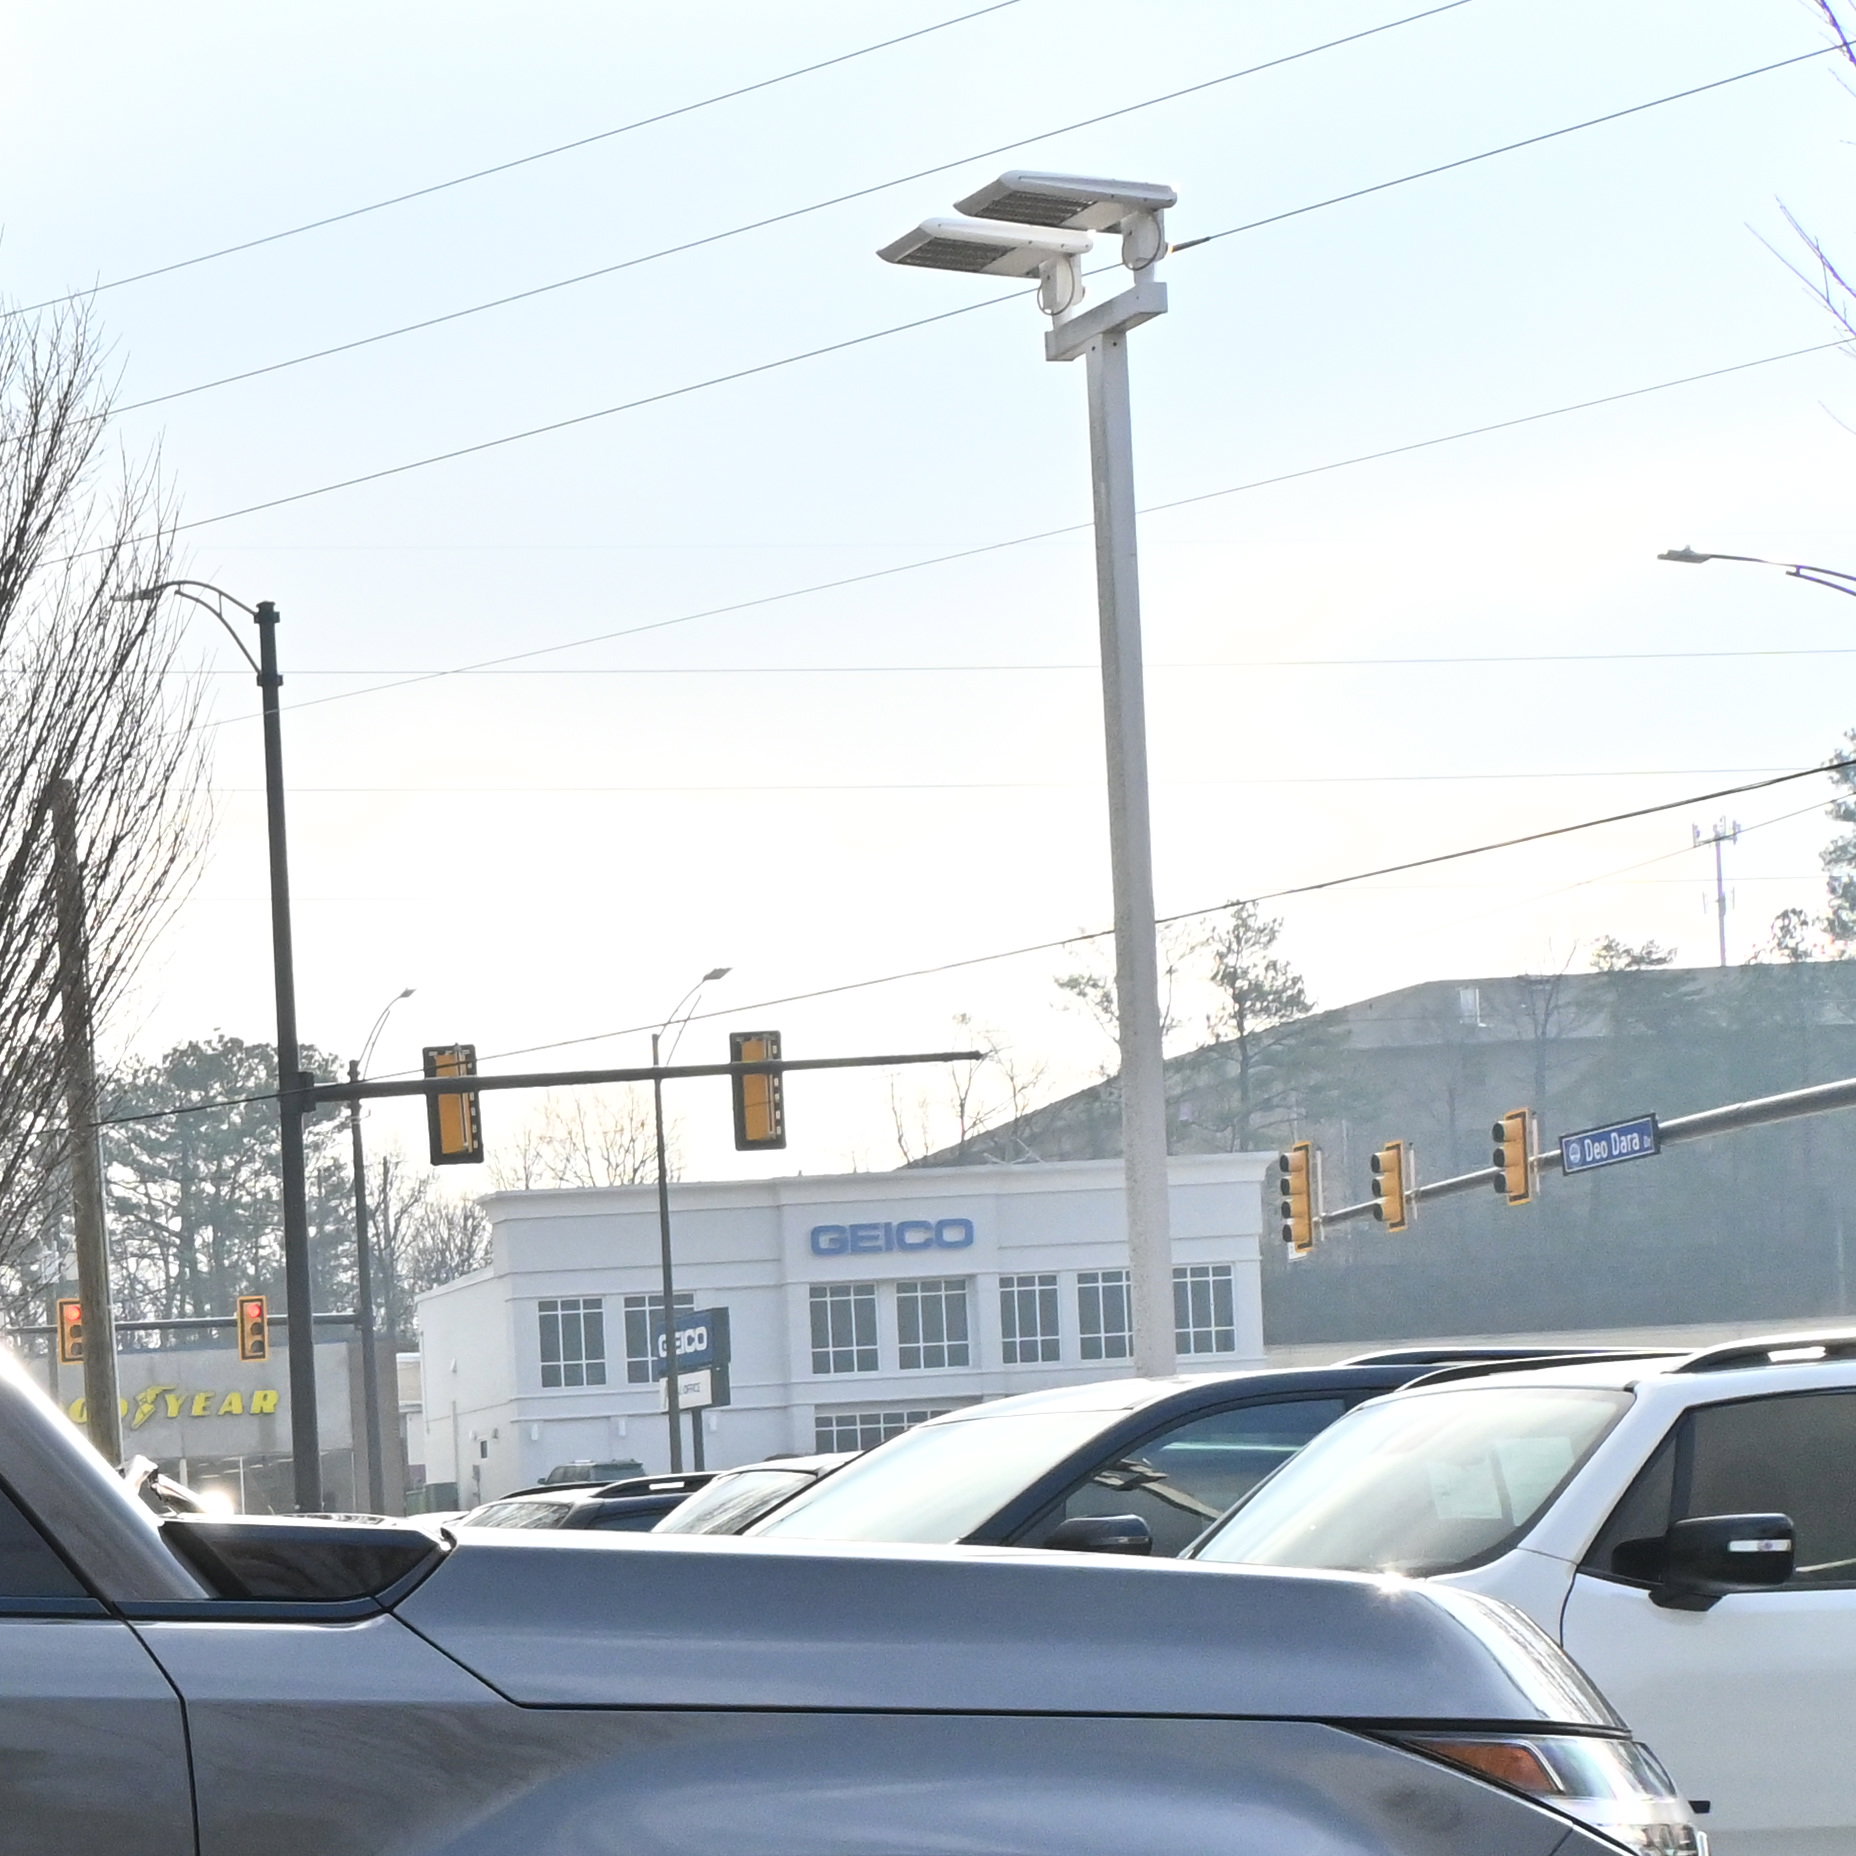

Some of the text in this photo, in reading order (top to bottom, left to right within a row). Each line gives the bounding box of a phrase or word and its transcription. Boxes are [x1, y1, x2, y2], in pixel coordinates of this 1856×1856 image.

[1583, 1138, 1608, 1162] Deo
[1610, 1132, 1640, 1156] Dara
[810, 1217, 975, 1257] GEICO
